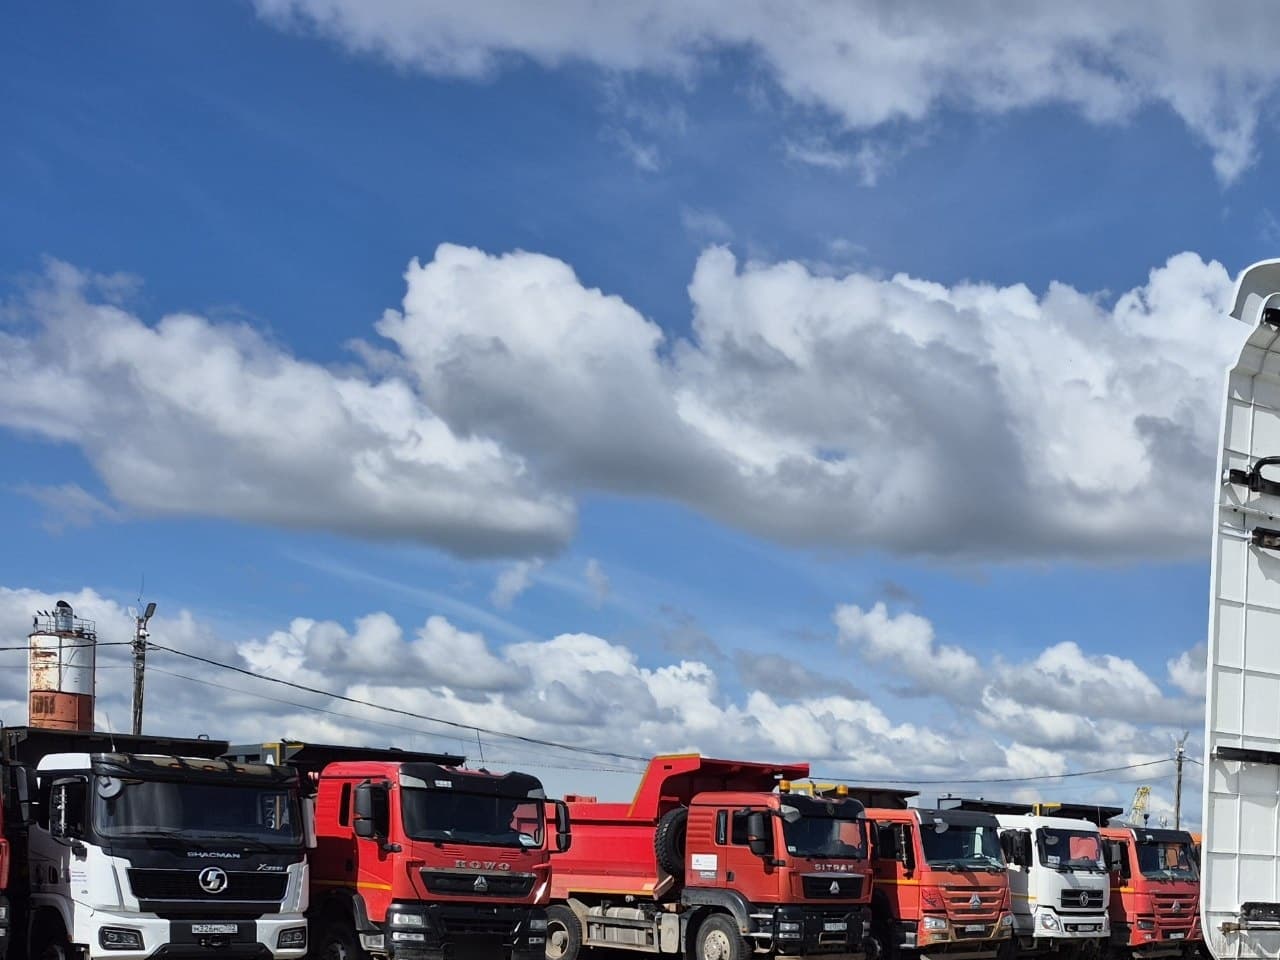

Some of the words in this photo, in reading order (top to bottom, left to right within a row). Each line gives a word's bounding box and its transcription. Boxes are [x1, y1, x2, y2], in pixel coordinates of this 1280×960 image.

[186, 851, 241, 859] SHACMAN
[455, 860, 511, 871] HOWO
[814, 863, 854, 873] SITRAK
